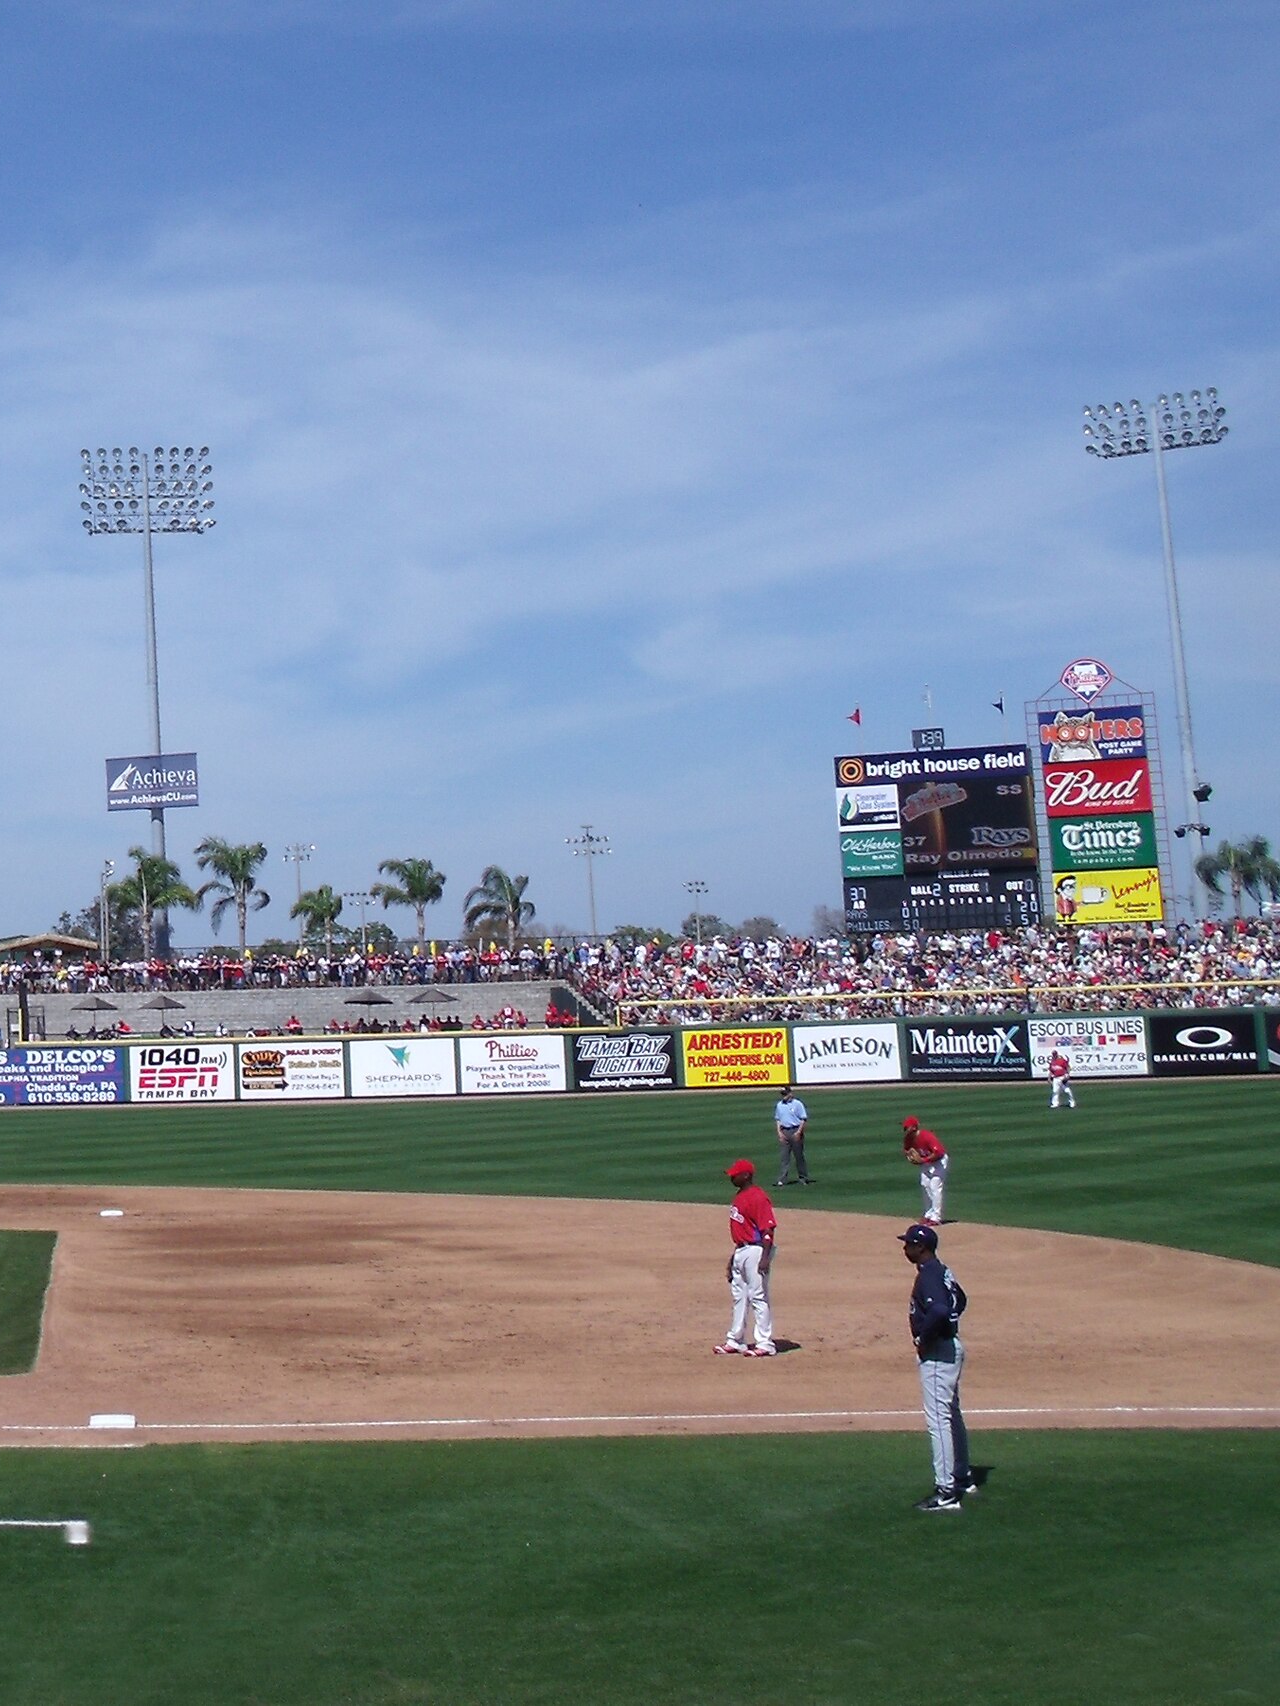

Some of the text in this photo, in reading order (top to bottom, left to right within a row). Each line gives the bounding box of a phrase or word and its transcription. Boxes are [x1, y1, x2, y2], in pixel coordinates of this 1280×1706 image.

[1040, 717, 1143, 745] HOOTERS
[1098, 740, 1143, 750] POST GAME
[1108, 747, 1134, 755] PARTY
[866, 751, 1025, 778] bright house field
[132, 768, 196, 785] Achieva
[1046, 769, 1143, 807] Bud
[904, 836, 926, 847] 37
[971, 826, 1031, 847] RAYS
[1061, 824, 1141, 851] Times
[905, 849, 1022, 865] Ray Olmedo
[911, 885, 932, 895] BALL
[932, 883, 941, 896] 2
[949, 883, 980, 893] STRIKE
[1006, 881, 1023, 891] OUT
[850, 888, 866, 901] 37
[853, 900, 866, 909] AB
[847, 920, 890, 931] PHILLIES
[1030, 1020, 1144, 1037] ESCOT BUS LINES
[578, 1034, 670, 1060] TAMPA BAY
[687, 1032, 784, 1051] ARRESTED?
[910, 1026, 1020, 1056] MaintenX
[485, 1040, 538, 1059] Phillies
[797, 1036, 894, 1063] JAMESON
[26, 1050, 116, 1064] DELCO'S
[139, 1048, 218, 1067] 1040 AM
[688, 1054, 783, 1068] FLORIDADEFENSE.COM
[1075, 1051, 1146, 1064] 571-7778
[29, 1063, 52, 1073] and
[55, 1062, 105, 1074] Hoagies
[465, 1065, 497, 1074] Players
[507, 1062, 561, 1072] Organization
[592, 1054, 669, 1077] LIGHTNING
[30, 1074, 79, 1082] TRADITION
[138, 1067, 219, 1089] ESPN
[365, 1073, 442, 1083] SHEPHARD'S
[509, 1072, 524, 1080] The
[579, 1077, 673, 1088] tampabaylightning.com
[26, 1081, 117, 1094] Chadds Ford, PA
[501, 1080, 525, 1088] Great
[27, 1092, 116, 1103] 610-558-8289
[138, 1089, 218, 1099] TAMPA BAY
